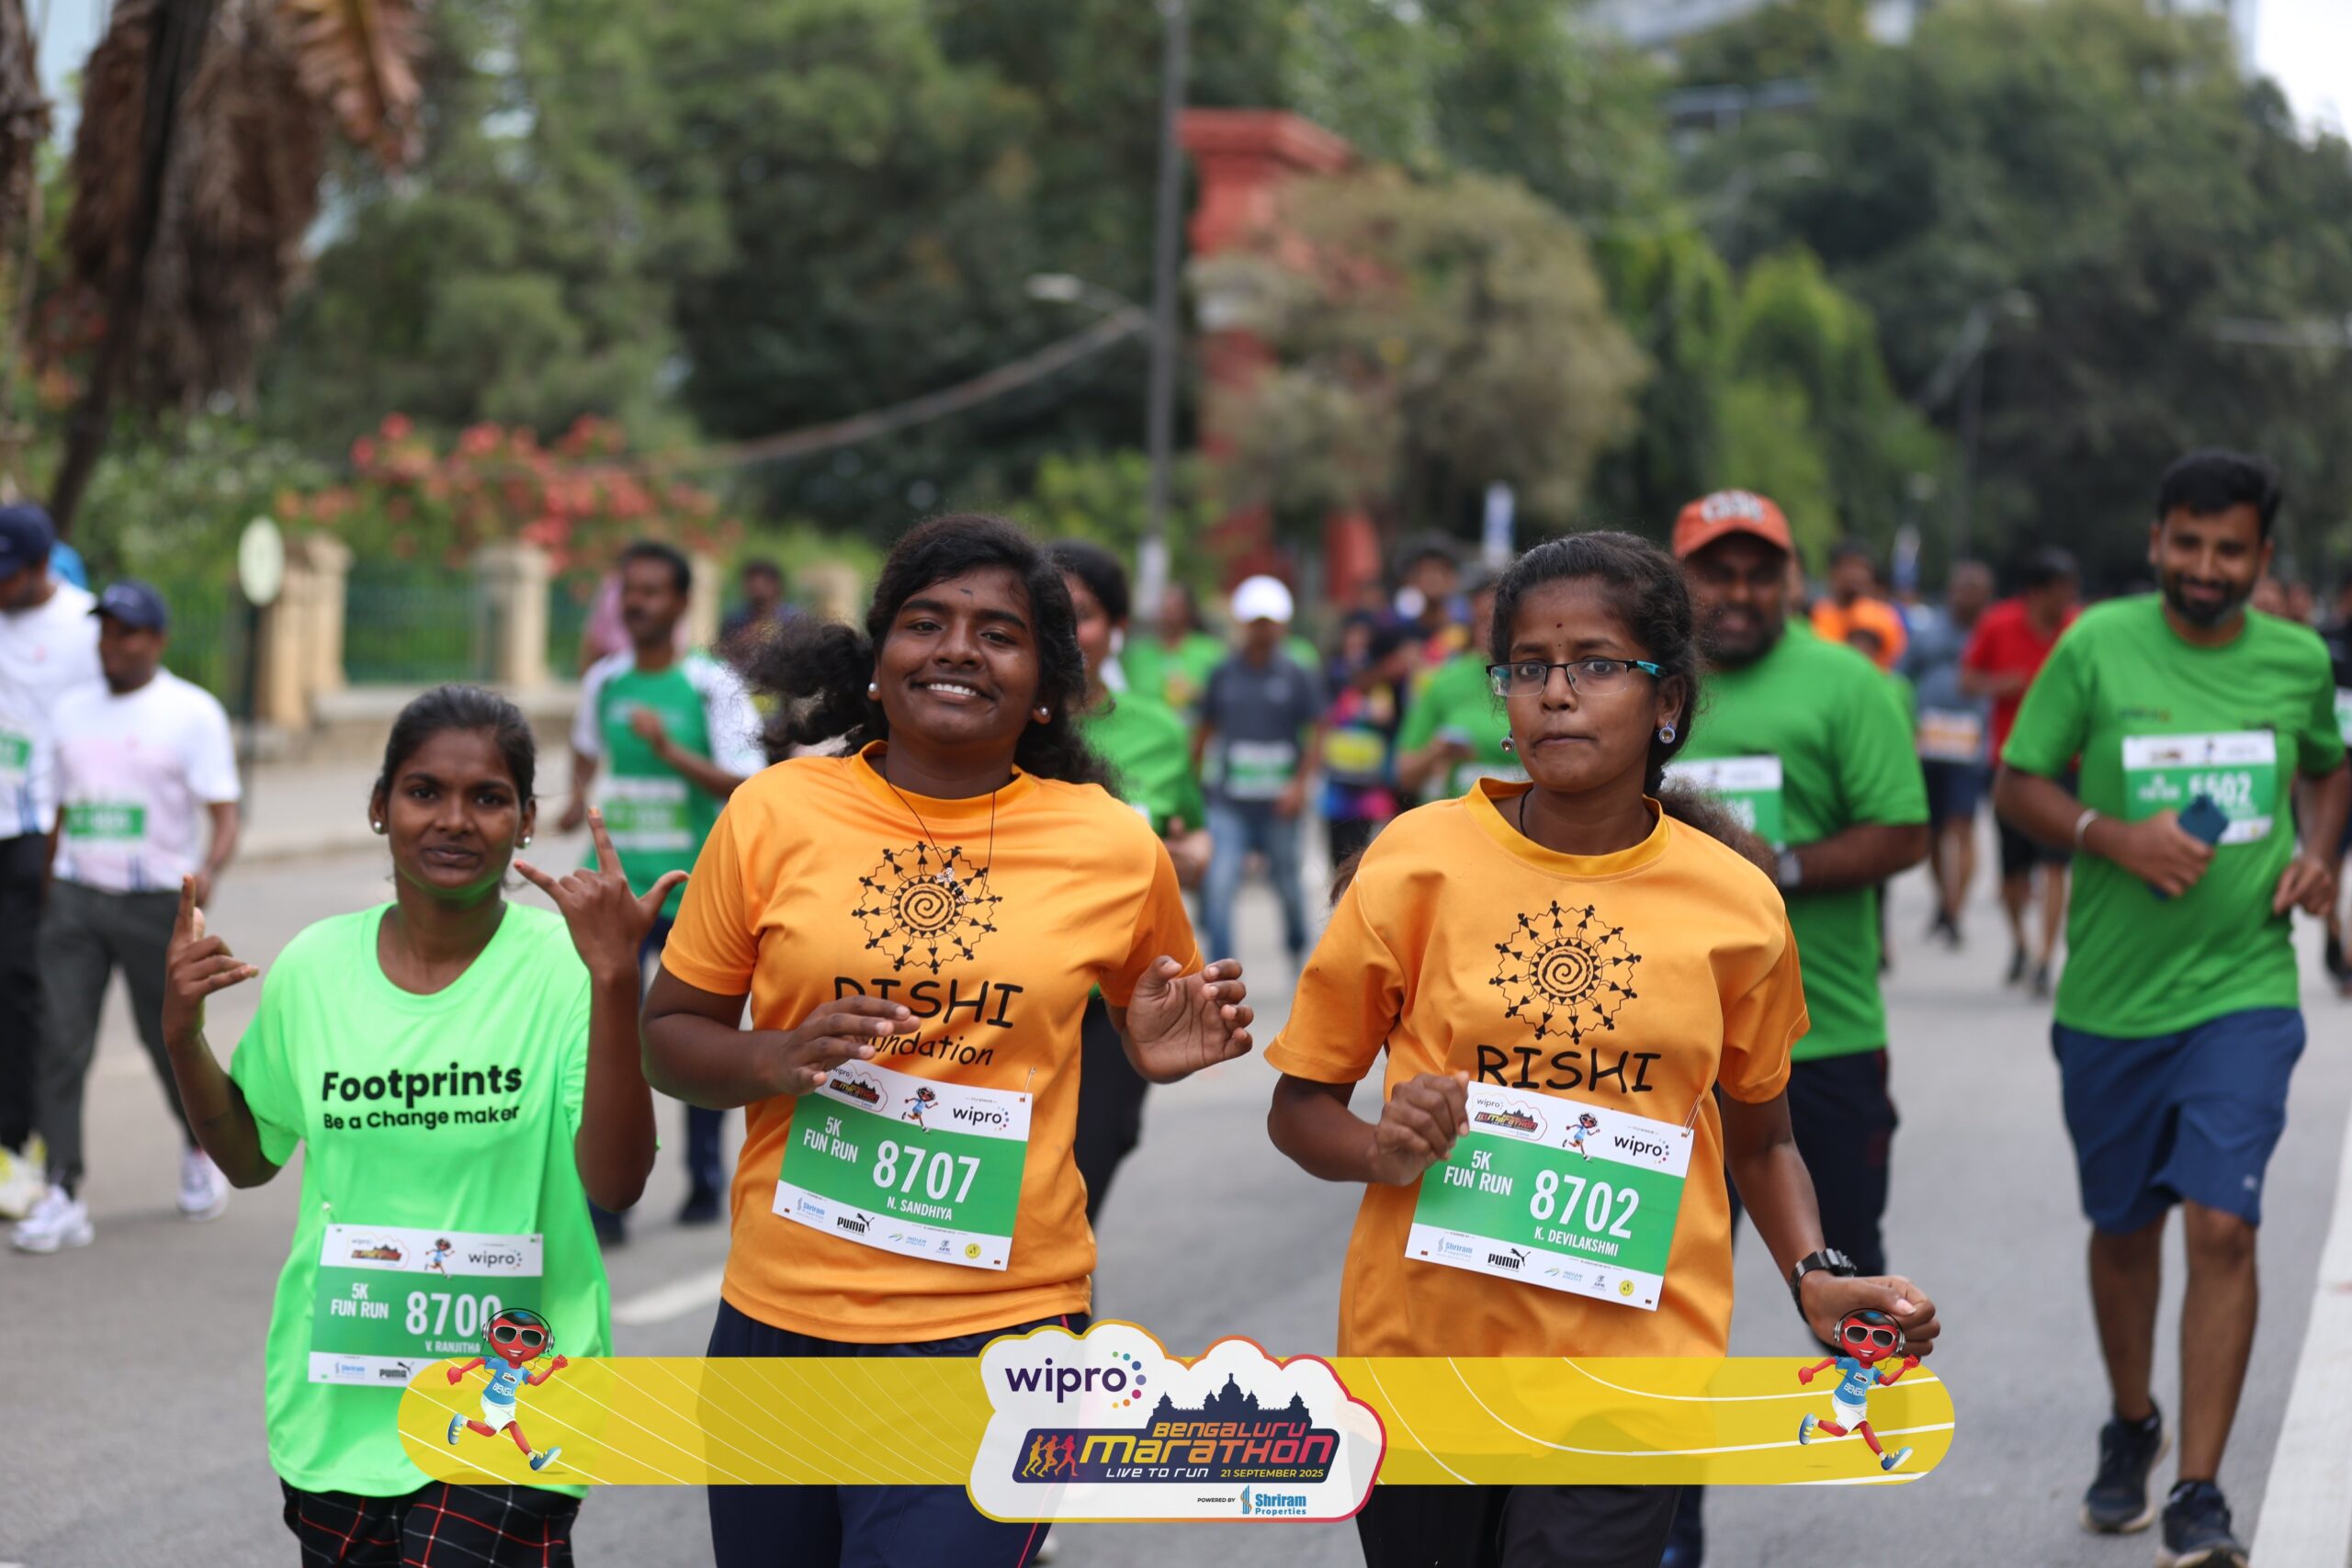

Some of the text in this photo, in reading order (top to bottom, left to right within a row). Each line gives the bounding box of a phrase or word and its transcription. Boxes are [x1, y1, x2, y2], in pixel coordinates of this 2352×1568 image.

[871, 1032, 993, 1066] undation
[1476, 1043, 1661, 1093] RISHI
[322, 1062, 522, 1109] Footprints
[1476, 1098, 1500, 1108] wipro
[323, 1106, 519, 1130] Be a Change maker
[953, 1105, 1002, 1125] wipro
[824, 1116, 842, 1137] 5K
[803, 1128, 858, 1163] FUN RUN
[1614, 1135, 1662, 1156] wipro
[1471, 1150, 1491, 1170] 5K
[873, 1140, 980, 1203] 8707
[1443, 1166, 1513, 1196] FUN RUN
[887, 1196, 952, 1221] N. SANDHIYA
[1530, 1169, 1639, 1239] 8702
[837, 1216, 865, 1233] PUMA
[1445, 1241, 1473, 1255] Shriram
[1534, 1225, 1620, 1257] K. DEVILAKSHMI
[469, 1251, 514, 1268] wipro
[1487, 1253, 1521, 1269] PUMA
[351, 1283, 368, 1299] 5K
[331, 1301, 389, 1319] FUN RUN
[435, 1341, 481, 1354] RANJITHA
